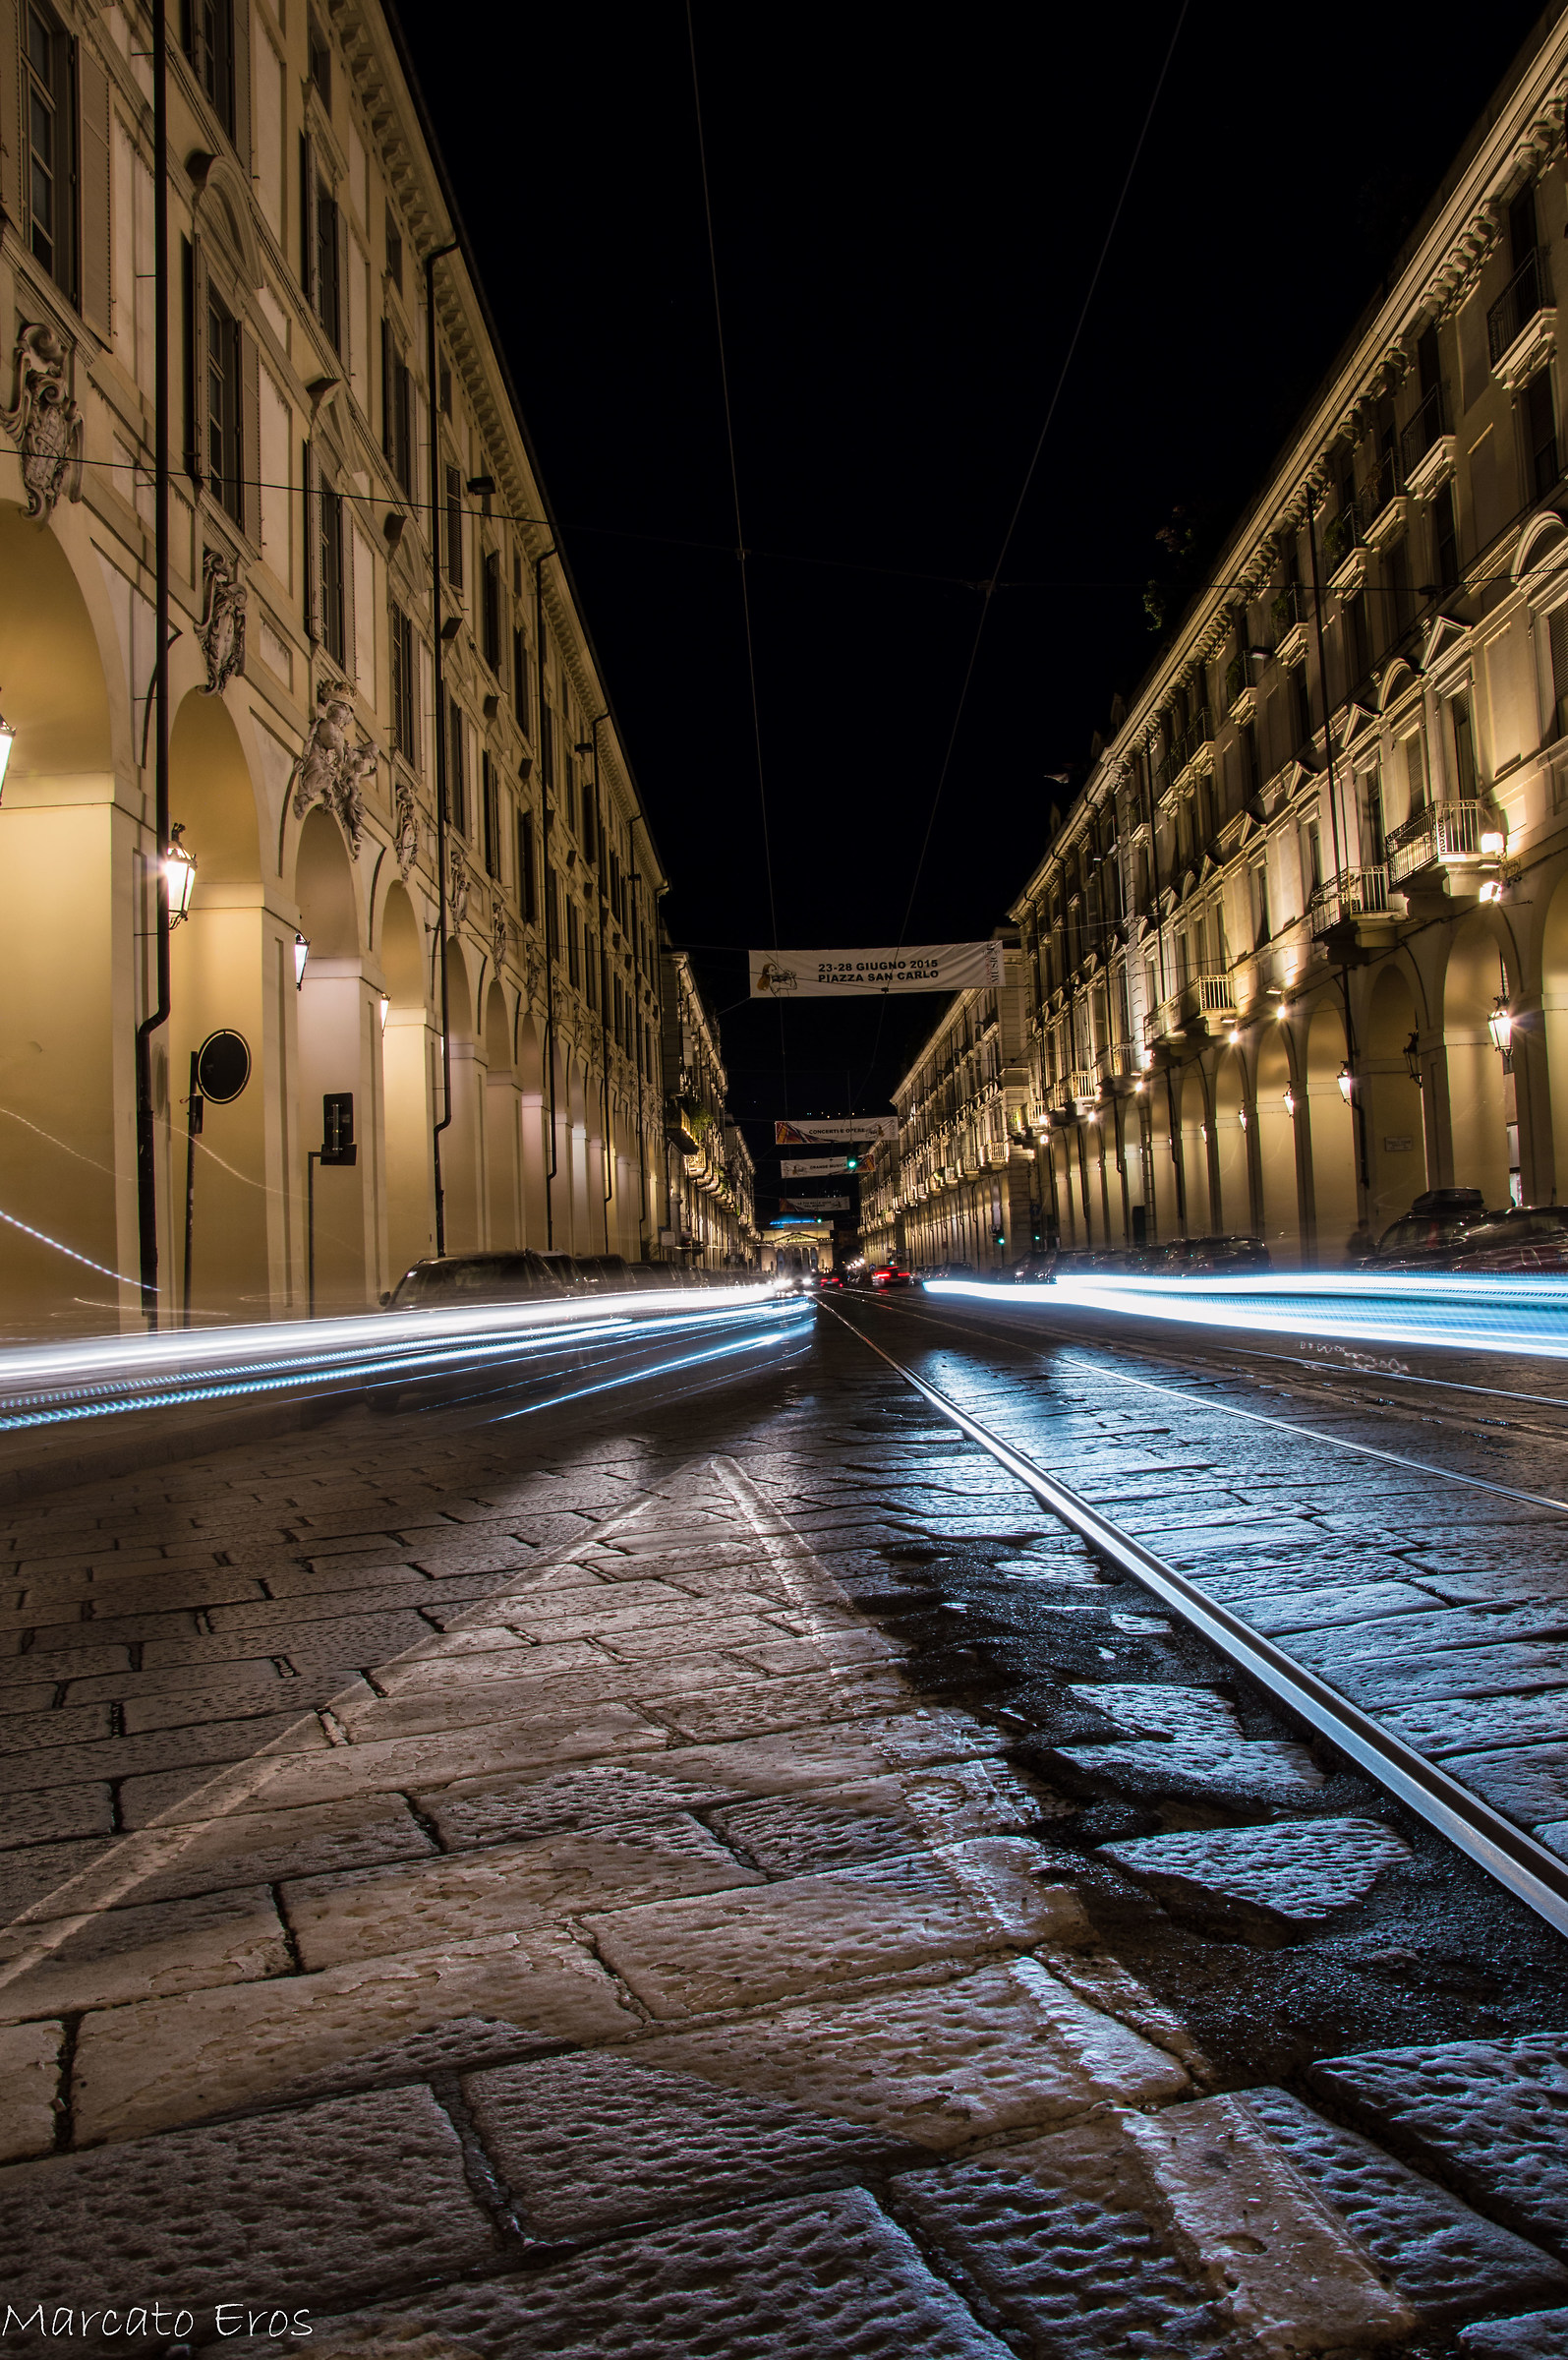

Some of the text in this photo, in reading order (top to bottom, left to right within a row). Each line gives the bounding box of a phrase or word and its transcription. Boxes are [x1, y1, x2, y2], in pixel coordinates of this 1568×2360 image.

[818, 959, 939, 973] 23-28 GIUGNO 2015
[818, 970, 939, 983] PIAZZA SAN CARLO
